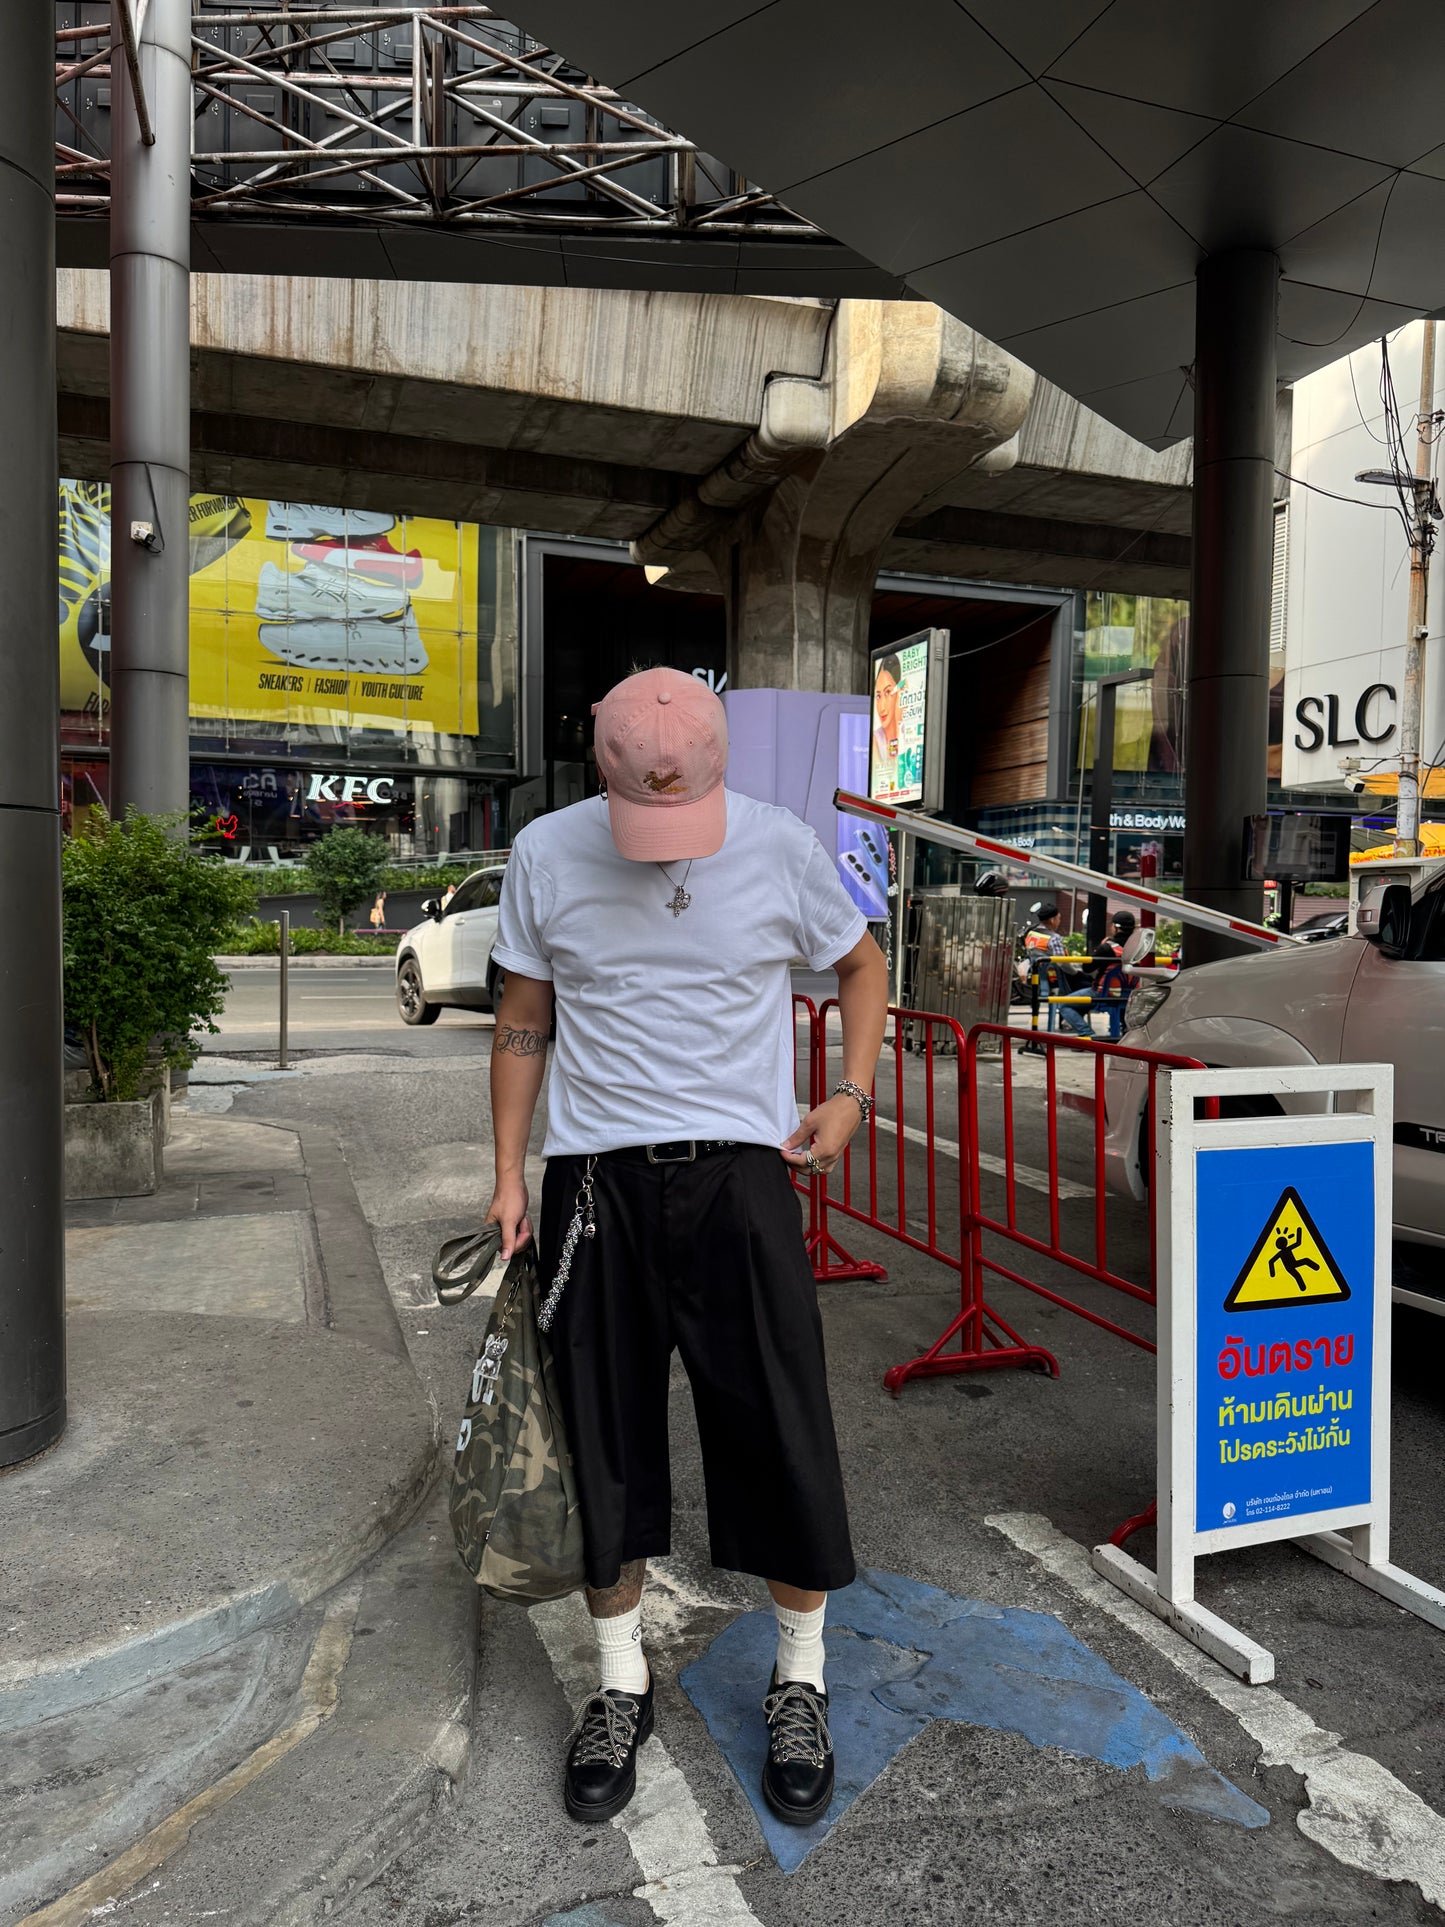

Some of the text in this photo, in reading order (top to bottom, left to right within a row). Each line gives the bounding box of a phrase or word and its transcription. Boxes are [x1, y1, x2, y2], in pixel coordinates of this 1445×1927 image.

[902, 655, 927, 673] BRIGHT
[258, 673, 425, 701] SNEAKERS FASHION YOUTH CULTURE
[1293, 683, 1398, 752] SLC
[306, 773, 395, 804] KFC
[1109, 812, 1122, 826] th
[1123, 813, 1133, 827] &
[1135, 814, 1168, 831] Body
[1017, 835, 1036, 848] Body
[1217, 1334, 1354, 1380] อันตราย
[1218, 1384, 1353, 1427] ห้ามเดินผ่าน
[1219, 1417, 1350, 1464] โปรดระวังไม้กั้น
